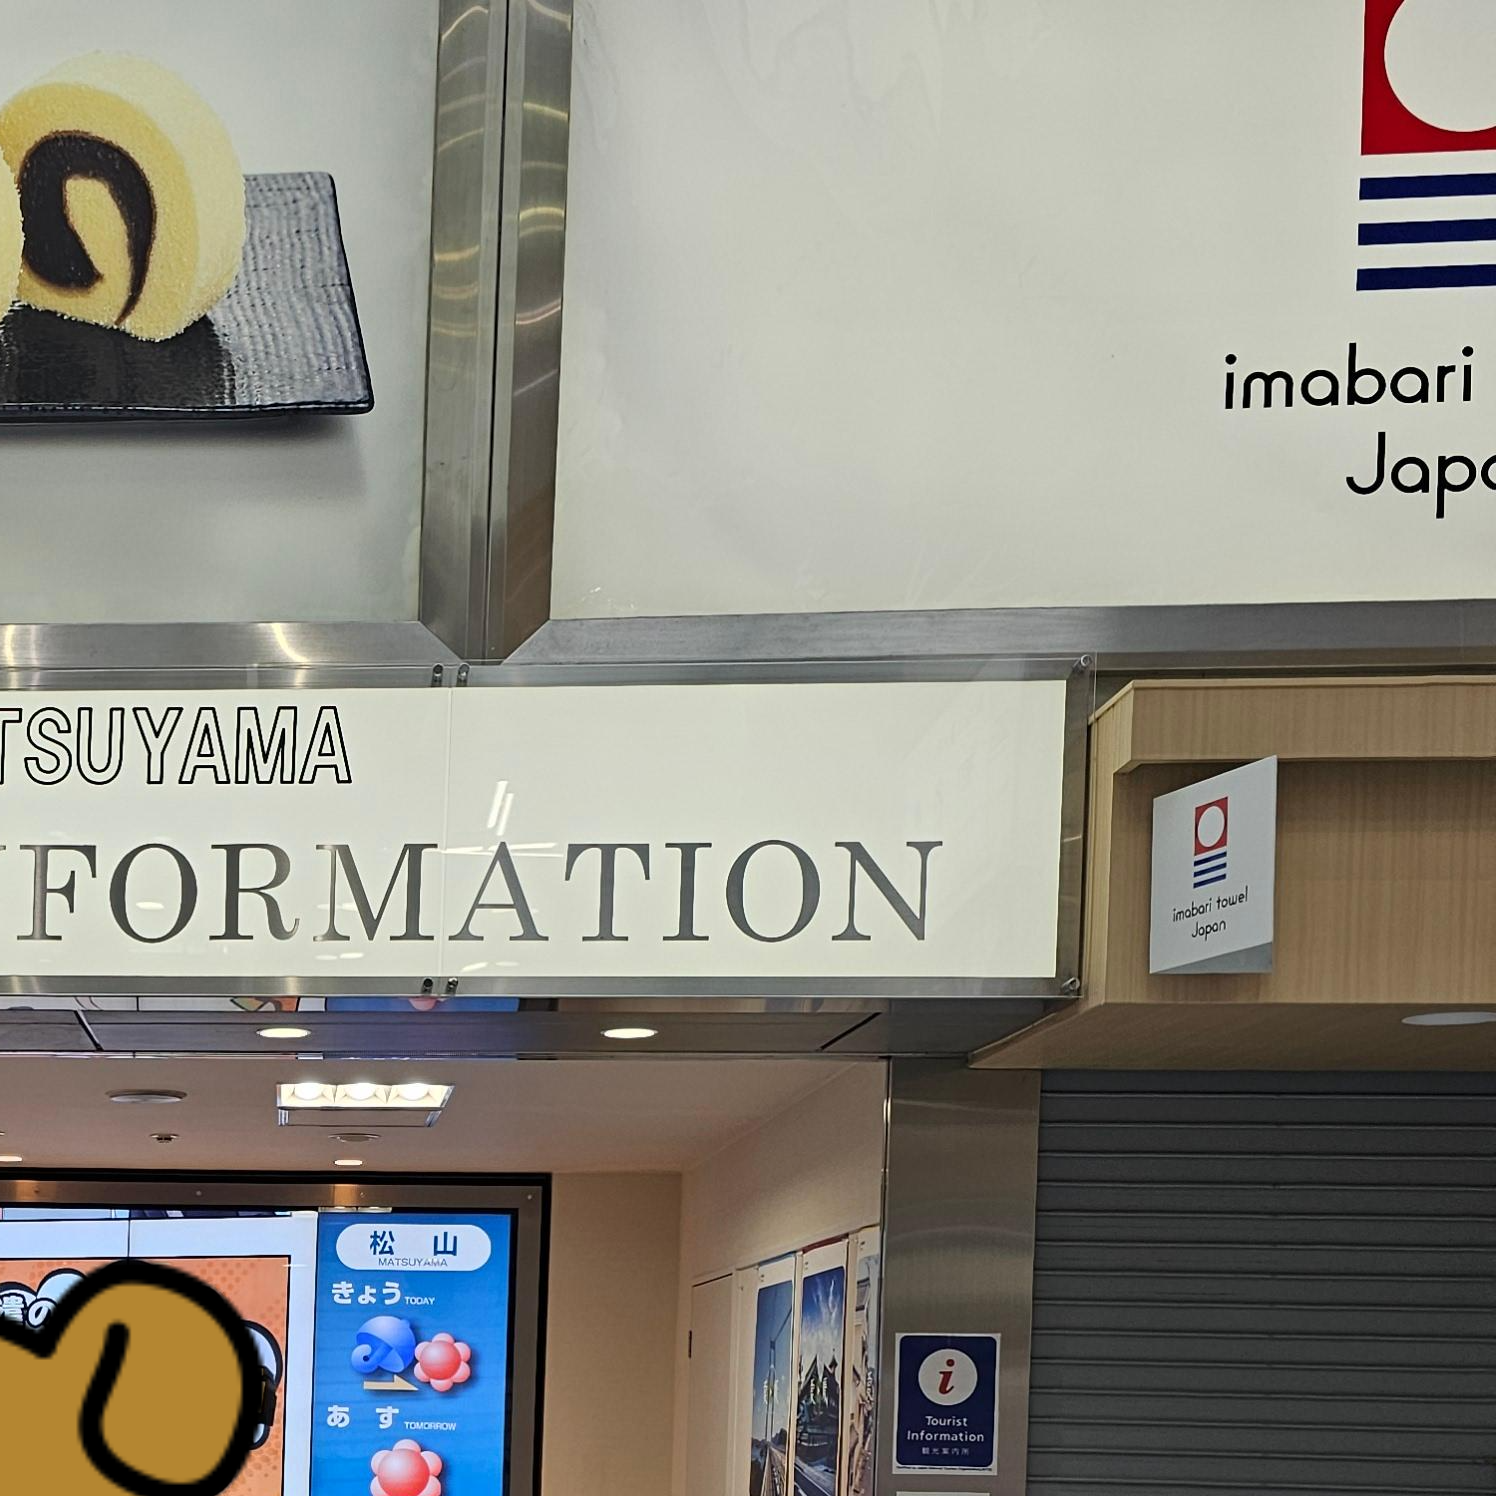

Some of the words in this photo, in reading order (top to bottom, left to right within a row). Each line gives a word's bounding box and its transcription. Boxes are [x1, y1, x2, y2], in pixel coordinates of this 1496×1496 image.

[1224, 342, 1474, 410] imabari
[1172, 897, 1212, 923] imabari
[1217, 885, 1249, 910] towel
[1191, 920, 1226, 941] Japan
[378, 1257, 448, 1267] MATSUYAMA
[331, 1280, 402, 1305] きょう
[405, 1297, 436, 1306] TODAY
[404, 1421, 457, 1431] TOMORROW
[925, 1415, 969, 1427] Tourist
[906, 1430, 985, 1443] Information
